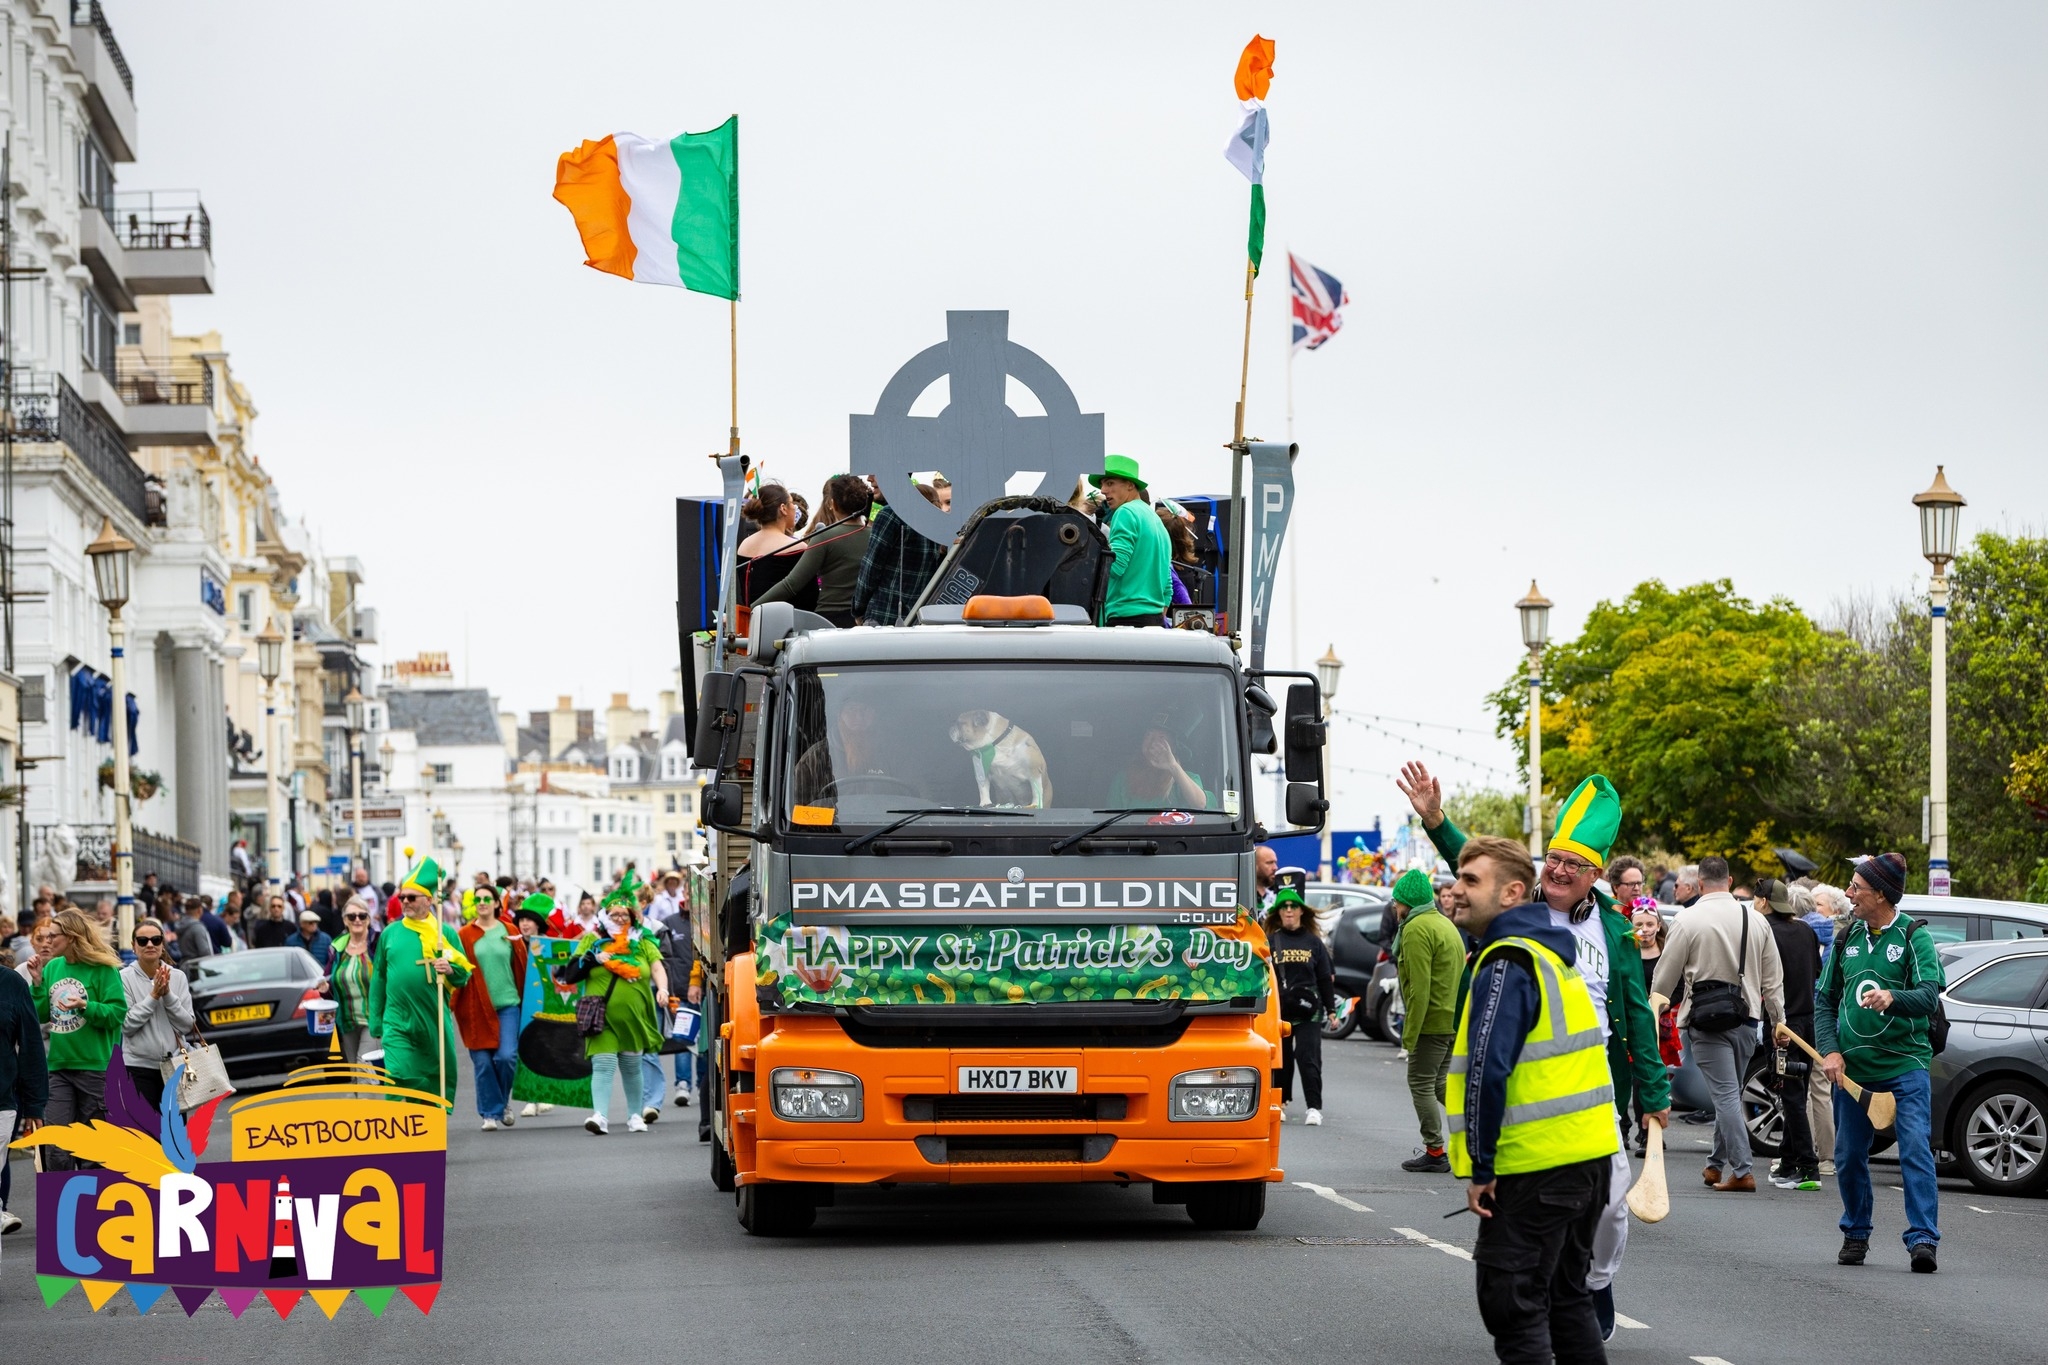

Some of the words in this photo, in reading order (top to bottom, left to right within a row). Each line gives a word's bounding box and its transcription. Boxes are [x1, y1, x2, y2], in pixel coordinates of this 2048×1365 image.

[1252, 483, 1285, 626] PMA
[936, 567, 980, 605] IAB
[1173, 912, 1237, 924] .CO.UK
[785, 935, 928, 969] HAPPY
[934, 933, 983, 970] St.
[986, 926, 1174, 972] Patrick's
[1189, 927, 1252, 971] Day
[1574, 935, 1605, 980] NTE
[49, 978, 85, 995] COLORADO
[968, 1070, 1022, 1089] HX07
[1028, 1070, 1068, 1089] BKV
